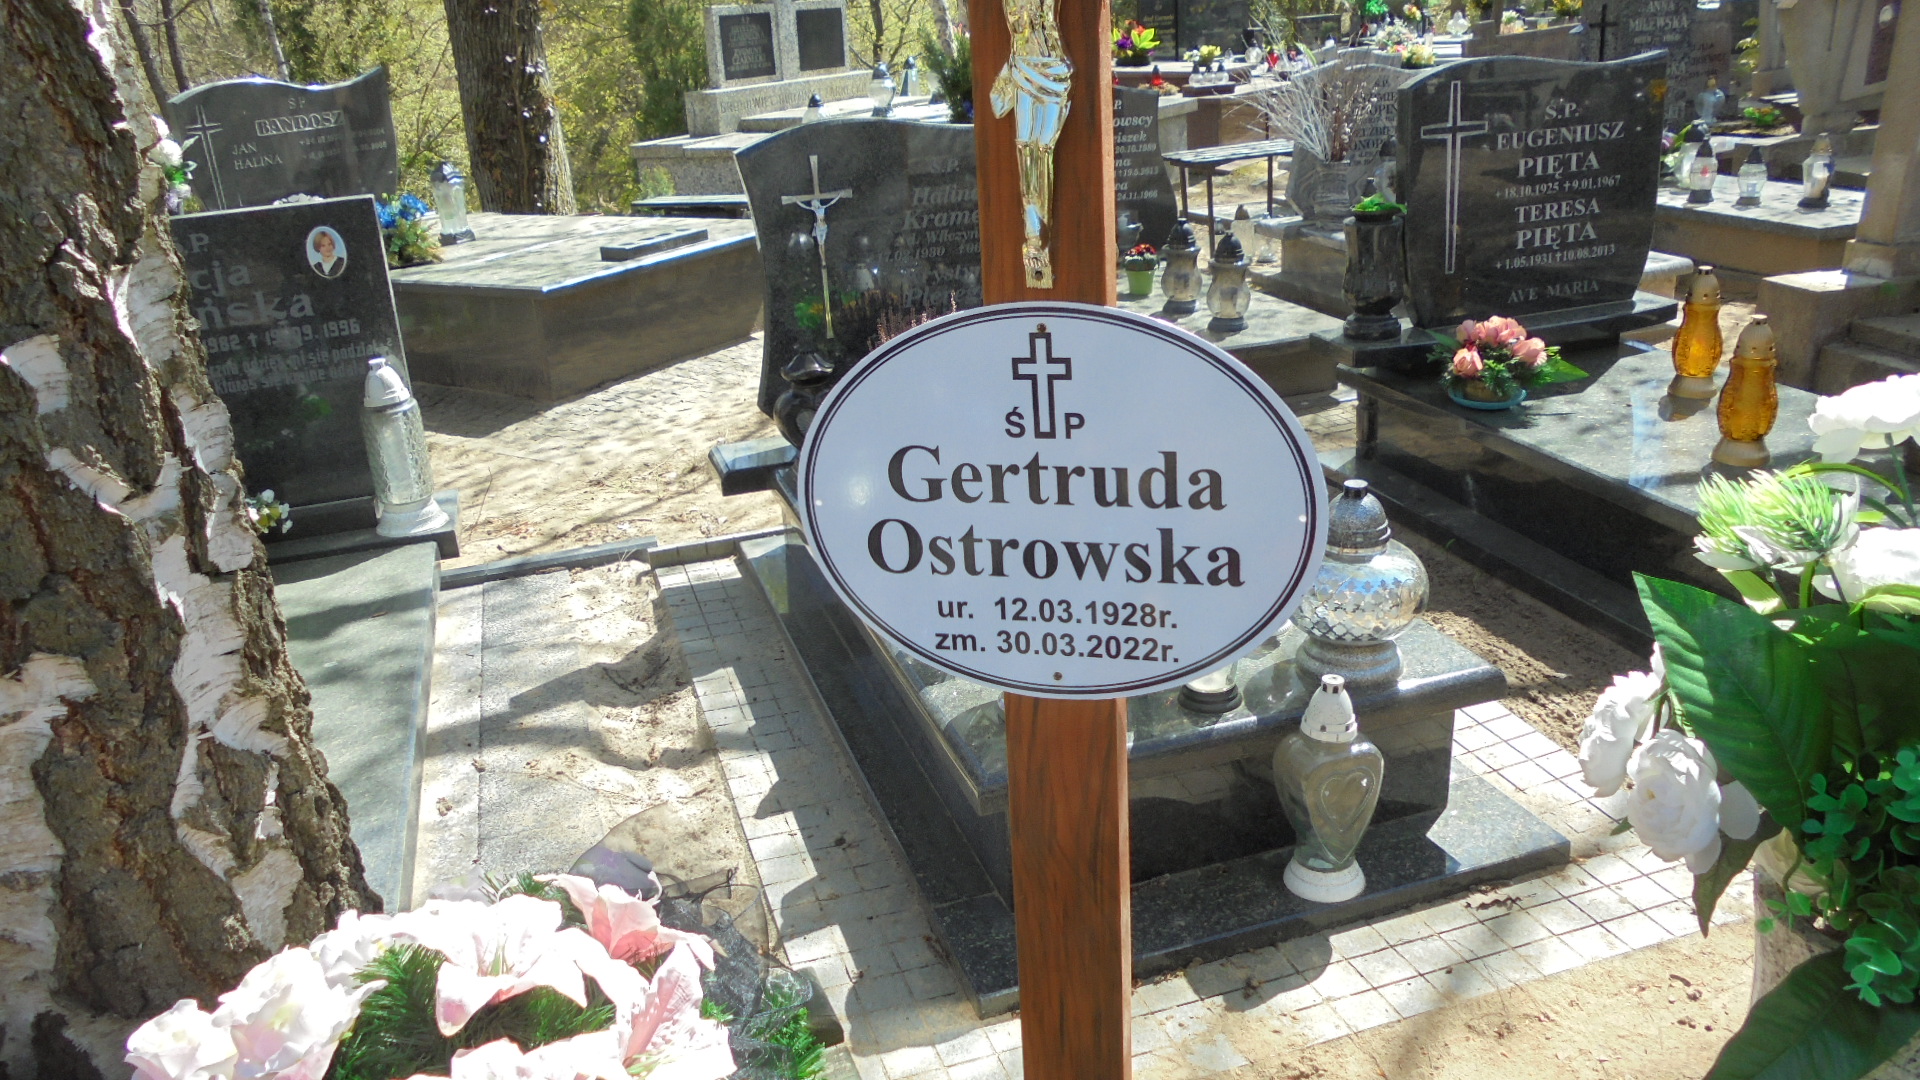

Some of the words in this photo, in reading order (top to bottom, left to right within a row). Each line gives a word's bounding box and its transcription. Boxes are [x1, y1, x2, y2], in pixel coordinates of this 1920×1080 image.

[255, 110, 345, 137] BANDOSZ
[1497, 121, 1625, 151] EUGENIUSZ
[232, 141, 258, 155] JAN
[234, 153, 283, 170] HALINA
[1517, 151, 1600, 179] PIĘTA
[1515, 198, 1600, 223] TERESA
[1516, 222, 1597, 249] PIĘTA
[189, 260, 256, 297] cja
[1507, 287, 1538, 303] AVE
[1546, 280, 1599, 298] MARIA
[888, 445, 1228, 512] Gertruda
[867, 518, 1246, 588] Ostrowska
[937, 600, 975, 620] ur.
[994, 597, 1179, 630] 12.03.1928r.
[934, 632, 986, 653] zm.
[997, 630, 1181, 664] 30.03.2022r.
